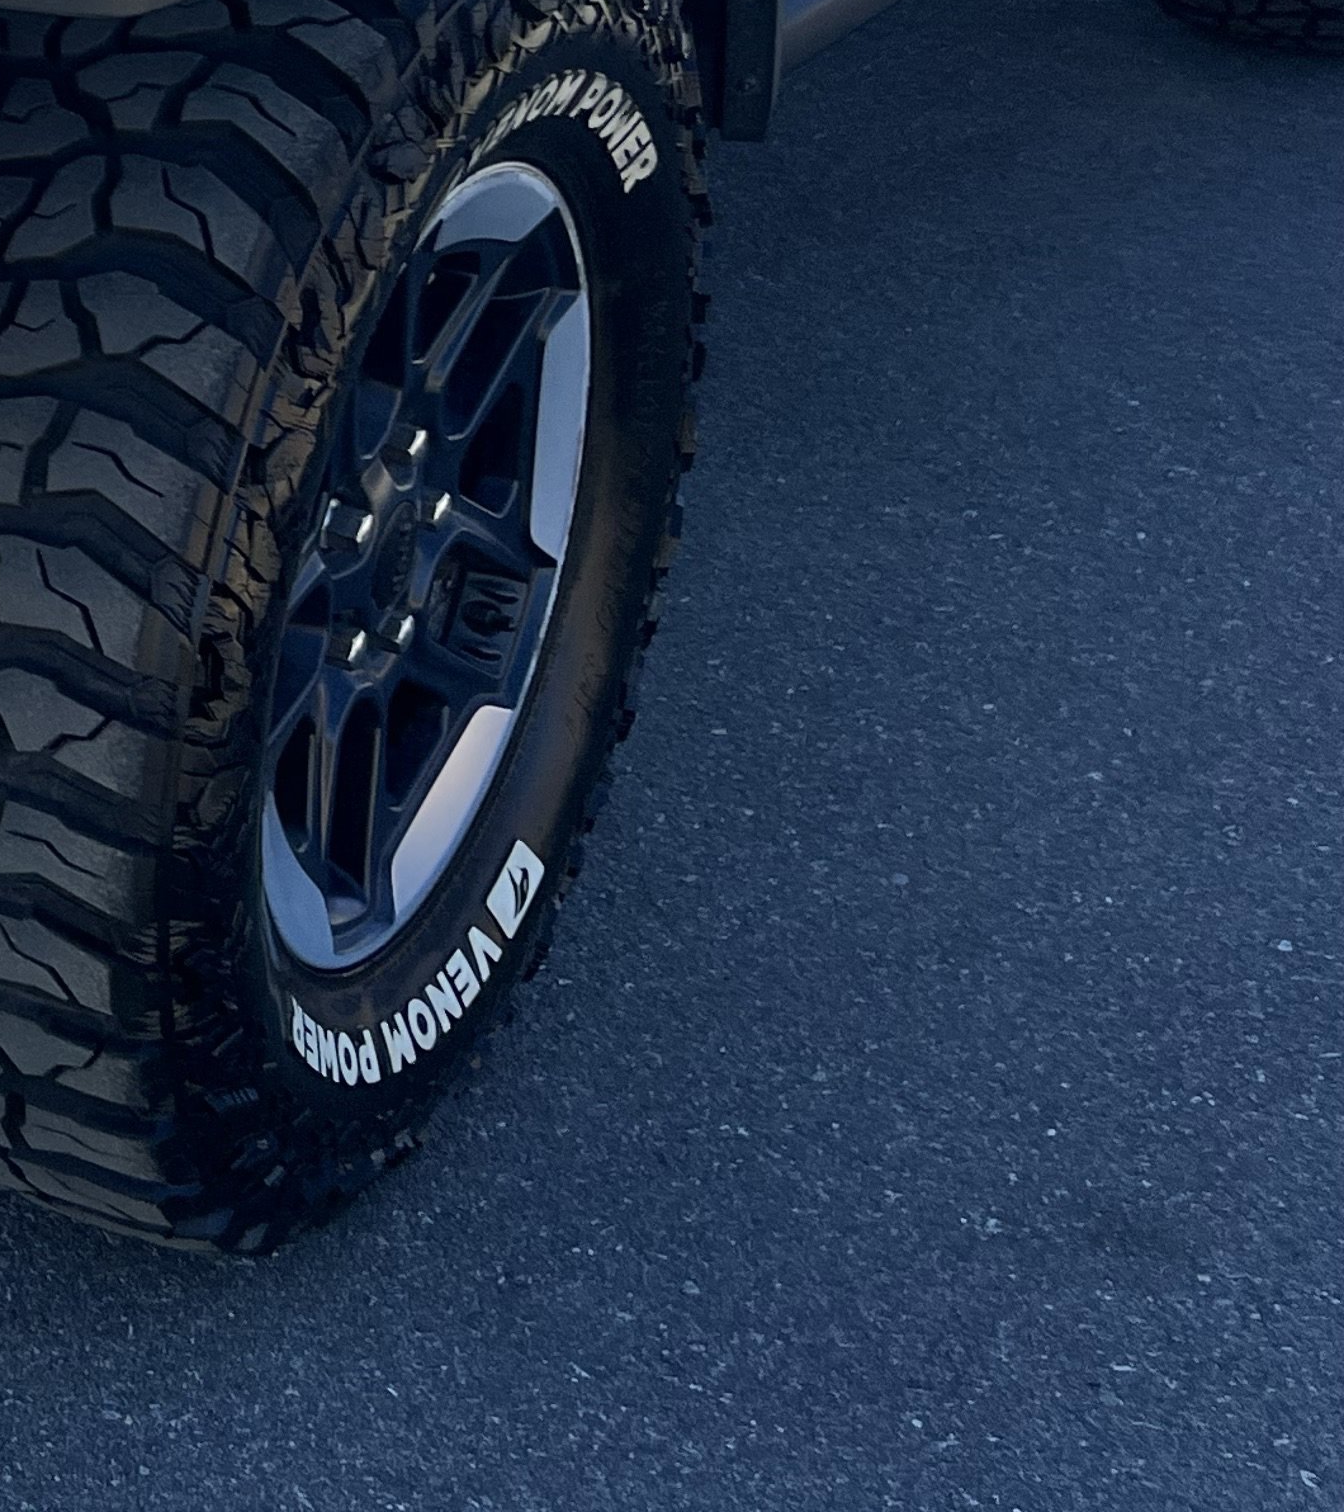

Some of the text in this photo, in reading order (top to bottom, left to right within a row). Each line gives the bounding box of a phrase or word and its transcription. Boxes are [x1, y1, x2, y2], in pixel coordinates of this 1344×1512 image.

[569, 72, 658, 194] POWER
[291, 926, 503, 1086] VENOM POWER
